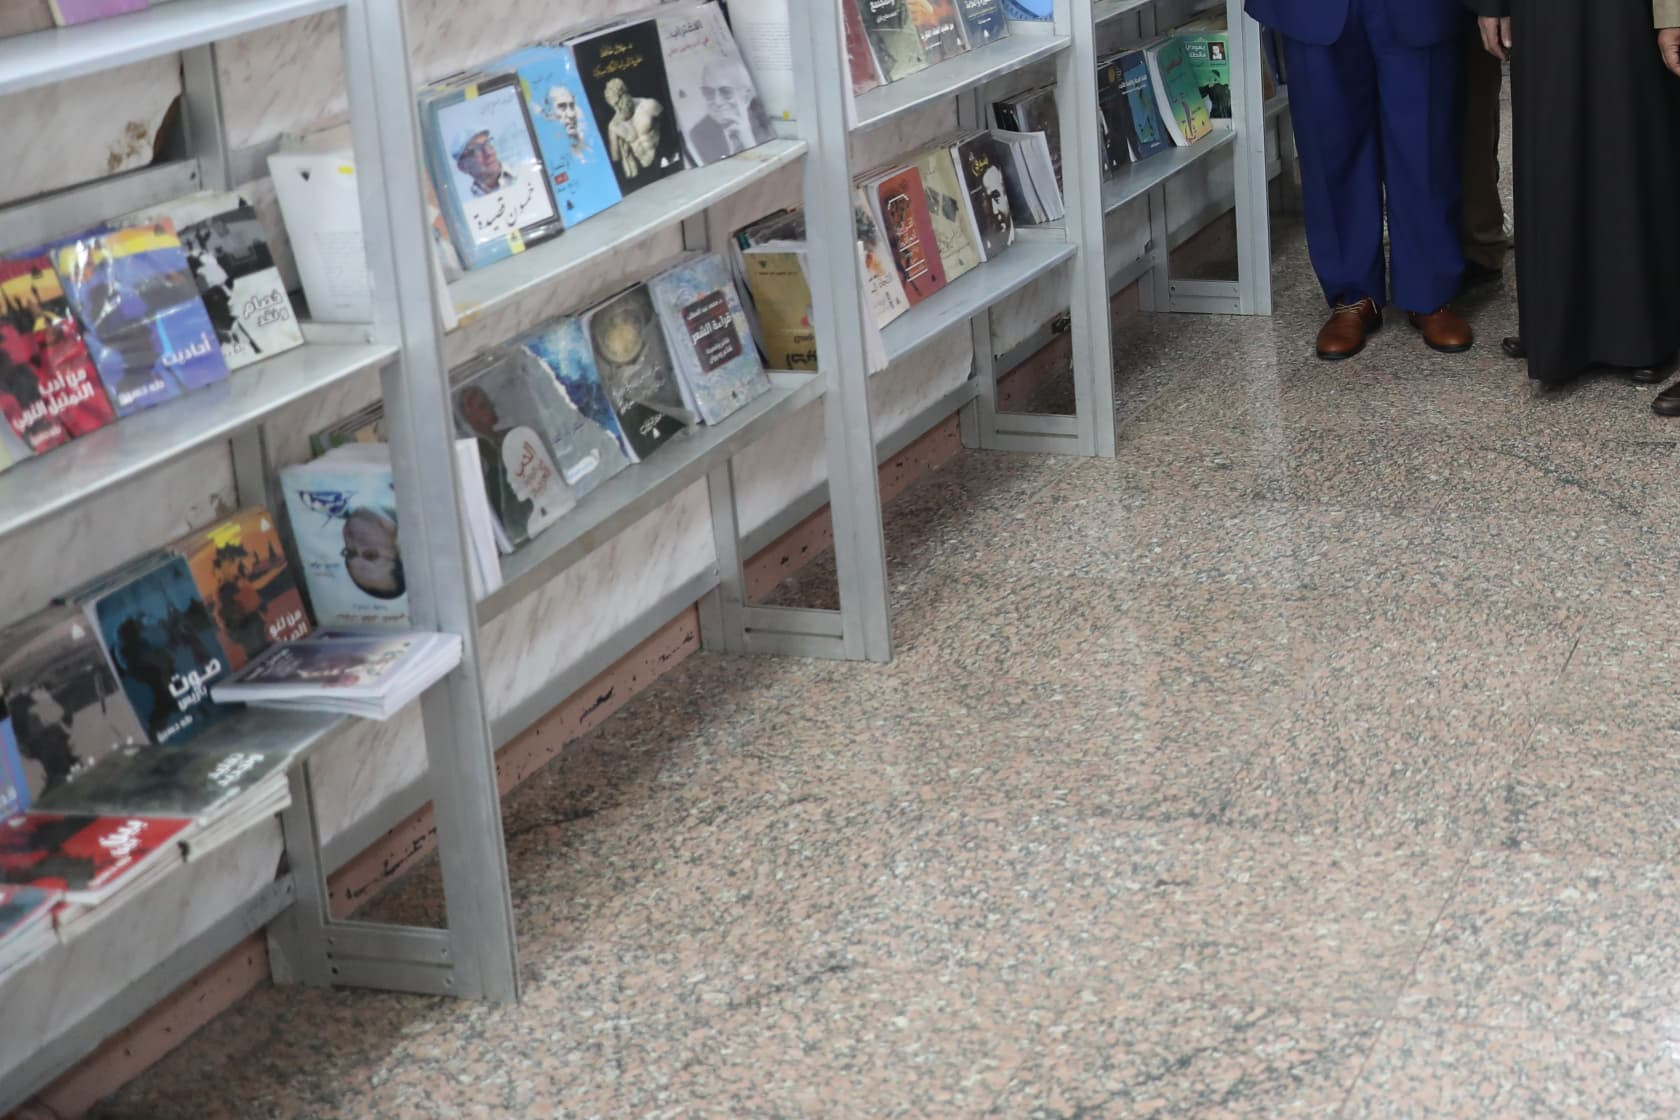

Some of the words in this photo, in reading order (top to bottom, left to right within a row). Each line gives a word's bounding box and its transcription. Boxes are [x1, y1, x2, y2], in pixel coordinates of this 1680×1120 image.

[473, 196, 506, 231] قصيدة
[161, 332, 213, 367] أحاديث
[168, 657, 222, 699] صوت
